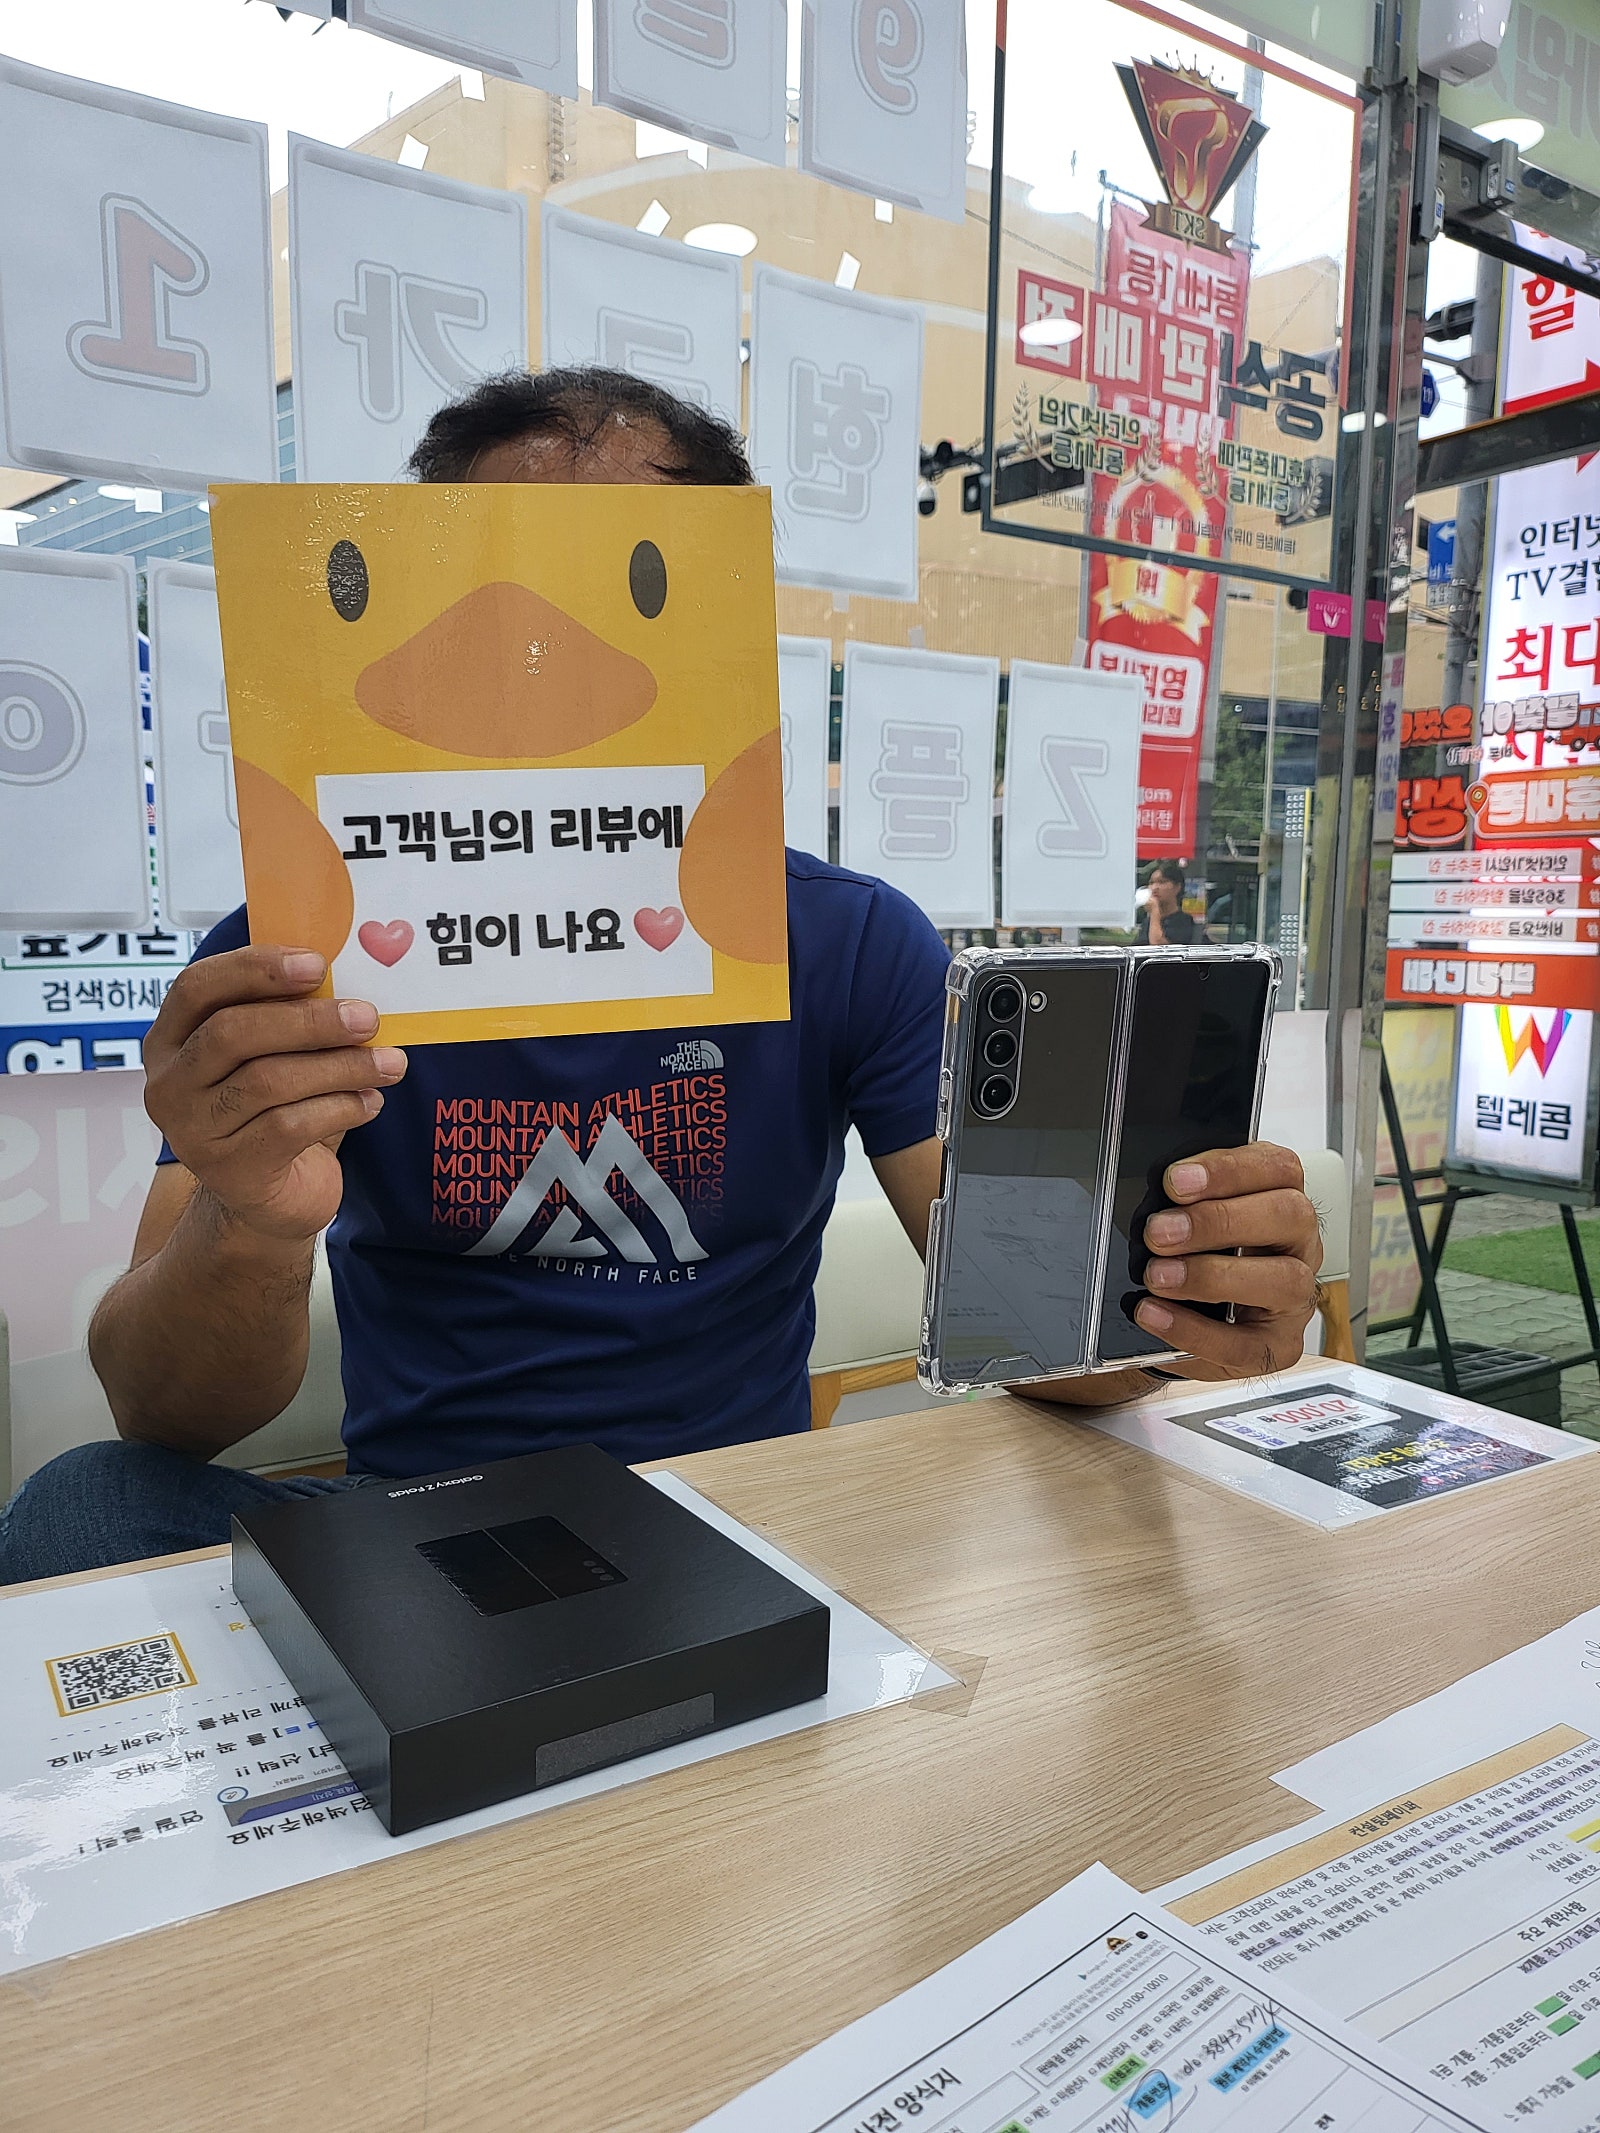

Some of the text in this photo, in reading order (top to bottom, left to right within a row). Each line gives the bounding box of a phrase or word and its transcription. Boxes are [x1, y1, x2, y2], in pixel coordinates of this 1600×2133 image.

[342, 805, 684, 863] 고객님의 리뷰에
[426, 907, 626, 967] 힘이 나요
[660, 1051, 701, 1068] NORTH
[671, 1061, 701, 1074] FACE
[677, 1040, 700, 1053] THE
[435, 1074, 727, 1127] MOUNTAIN ATHLETICS
[1476, 1094, 1572, 1141] 텔레콤
[538, 1255, 619, 1282] NORTH
[638, 1266, 698, 1284] FACE
[1256, 1398, 1359, 1424] 20,000원
[437, 1475, 484, 1488] Galaxy
[197, 1706, 262, 1730] 리뷰를
[216, 1742, 238, 1755] 꼭
[236, 1754, 303, 1778] 선택 !!
[96, 1826, 145, 1852] 클릭
[156, 1810, 205, 1830] 연필
[226, 1798, 375, 1846] 검색해주세요
[1348, 1799, 1423, 1839] 컨설팅페이퍼
[1224, 1896, 1281, 1924] 고객님과의
[1273, 1877, 1320, 1900] 약속사항
[1312, 1870, 1333, 1881] 및
[1325, 1860, 1354, 1875] 각종
[1346, 1839, 1398, 1865] 계약사항을
[1390, 1826, 1426, 1843] 명시한
[1418, 1809, 1459, 1830] 문서로서,
[1453, 1801, 1478, 1814] 개통
[1472, 1797, 1488, 1805] 후
[1482, 1785, 1514, 1801] 유의할
[1506, 1780, 1524, 1790] 점
[1527, 1764, 1558, 1780] 요금제
[1221, 1930, 1253, 1946] 등에
[1244, 1919, 1276, 1935] 대한
[1267, 1904, 1306, 1924] 내용을
[1298, 1893, 1328, 1908] 담고
[1320, 1873, 1369, 1897] 있습니다.
[1360, 1862, 1391, 1877] 또한,
[1382, 1844, 1426, 1866] 폰파라치
[1482, 1806, 1507, 1818] 개통
[1234, 1935, 1284, 1960] 방법으로
[1277, 1915, 1328, 1940] 악용하여,
[1319, 1895, 1367, 1919] 판매점에
[1357, 1880, 1396, 1900] 금전적
[1387, 1866, 1424, 1884] 손해가
[1417, 1852, 1452, 1869] 발생할
[1444, 1842, 1471, 1856] 경우
[1477, 1819, 1518, 1840] 형사상의
[1292, 1938, 1323, 1954] 즉시
[1312, 1909, 1382, 1943] 개통번호해지
[1370, 1903, 1390, 1914] 등
[1384, 1897, 1403, 1907] 본
[1395, 1882, 1433, 1900] 계약이
[1423, 1863, 1468, 1886] 파기됨과
[1459, 1850, 1494, 1867] 동시에
[1486, 1834, 1528, 1855] 손해배상
[1562, 1863, 1600, 1885] 전화번호
[1515, 1898, 1589, 1944] 주요 계약사항
[1542, 1945, 1562, 1960] 전
[1554, 1933, 1582, 1953] 기기
[1573, 1921, 1600, 1941] 절대
[1033, 2051, 1069, 2077] 판매점
[1057, 2033, 1092, 2058] 연락처
[1101, 1971, 1172, 2022] 010-0100-10010
[1090, 2039, 1133, 2070] 개인사업자
[1133, 2021, 1156, 2038] 법인
[1155, 1998, 1185, 2020] 외국인
[1143, 2036, 1165, 2053] 본인
[1165, 2013, 1194, 2034] 대리인
[1447, 1976, 1594, 2069] 개통 개통일로부터 일 이후
[1458, 2067, 1489, 2090] 개통
[1487, 2027, 1554, 2072] 개통일로부터
[1566, 2007, 1587, 2022] 일
[890, 2064, 963, 2119] 양식지
